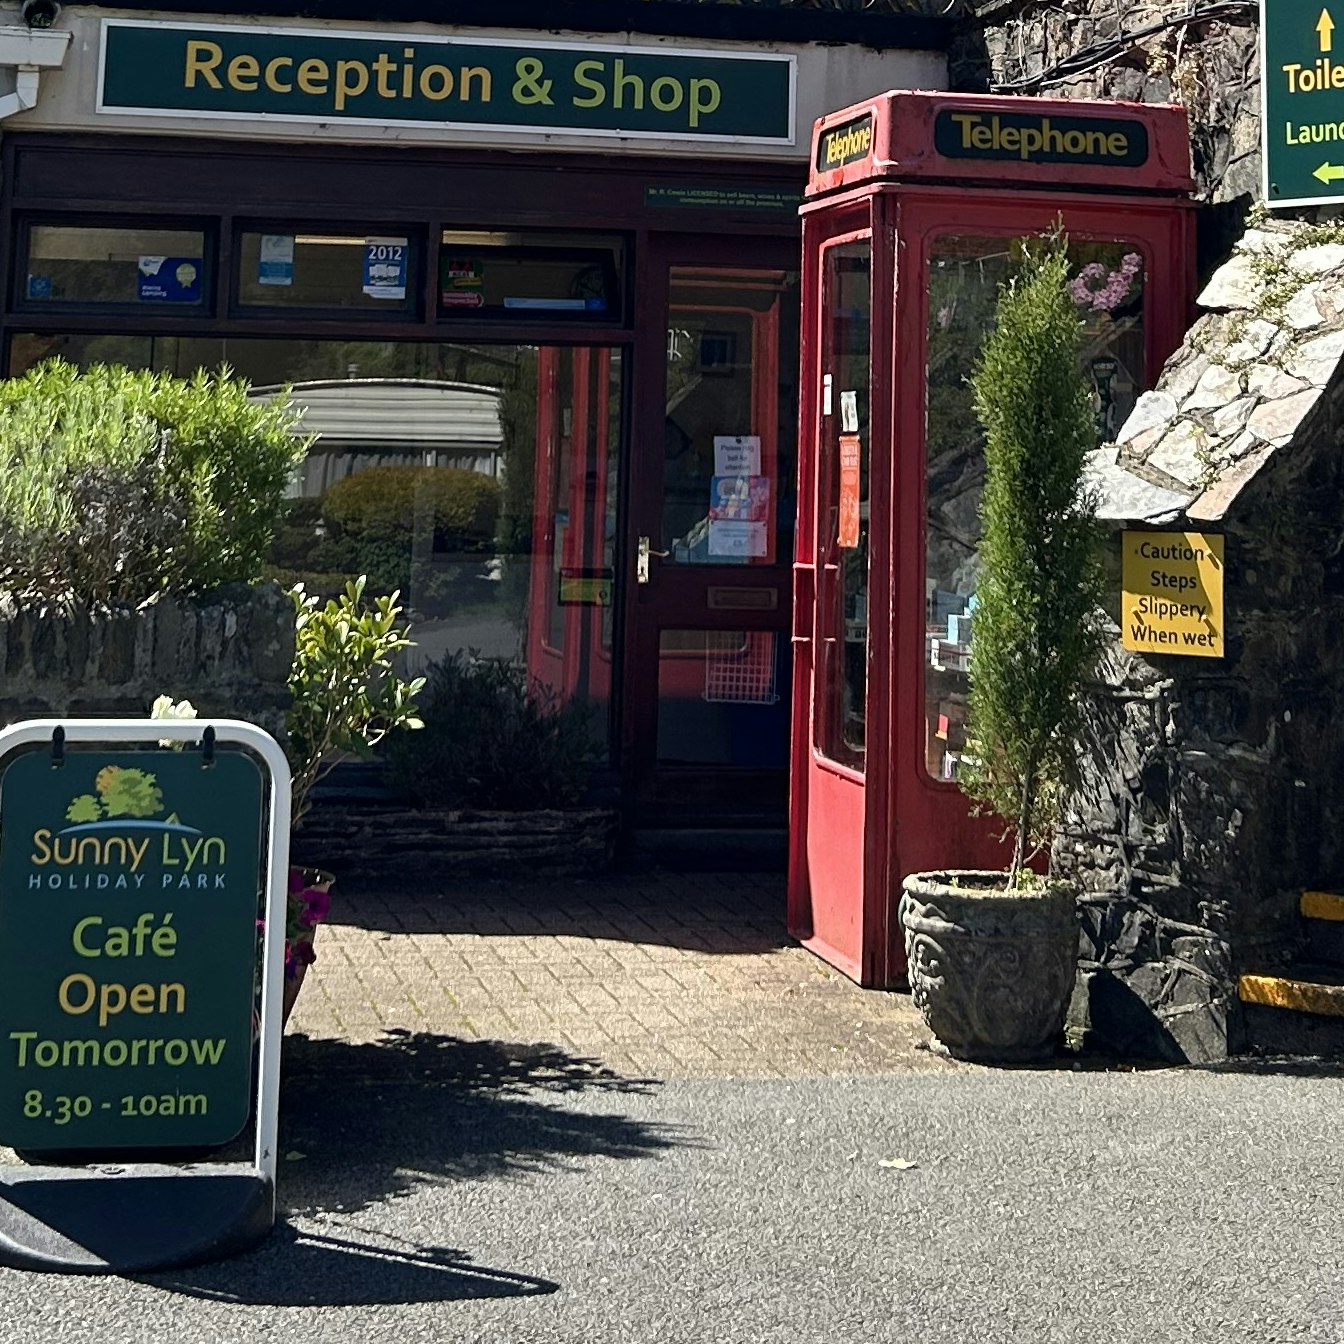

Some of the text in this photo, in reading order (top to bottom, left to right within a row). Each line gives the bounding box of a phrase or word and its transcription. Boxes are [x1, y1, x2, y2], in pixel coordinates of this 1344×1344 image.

[183, 40, 722, 127] Reception & Shop
[825, 125, 871, 165] Telephone
[951, 113, 1129, 160] Telephone
[368, 245, 402, 261] 2012
[1140, 541, 1204, 561] Caution
[1150, 570, 1197, 593] Steps
[1138, 596, 1206, 623] Slippery
[1131, 624, 1218, 647] When wet
[31, 829, 226, 874] Sunny Lyn
[28, 873, 227, 890] HOLIDAY PARK
[72, 913, 177, 958] Café
[58, 973, 186, 1027] Open
[9, 1031, 226, 1067] Tomorrow
[23, 1089, 93, 1125] 8.30
[121, 1092, 208, 1117] 10am
